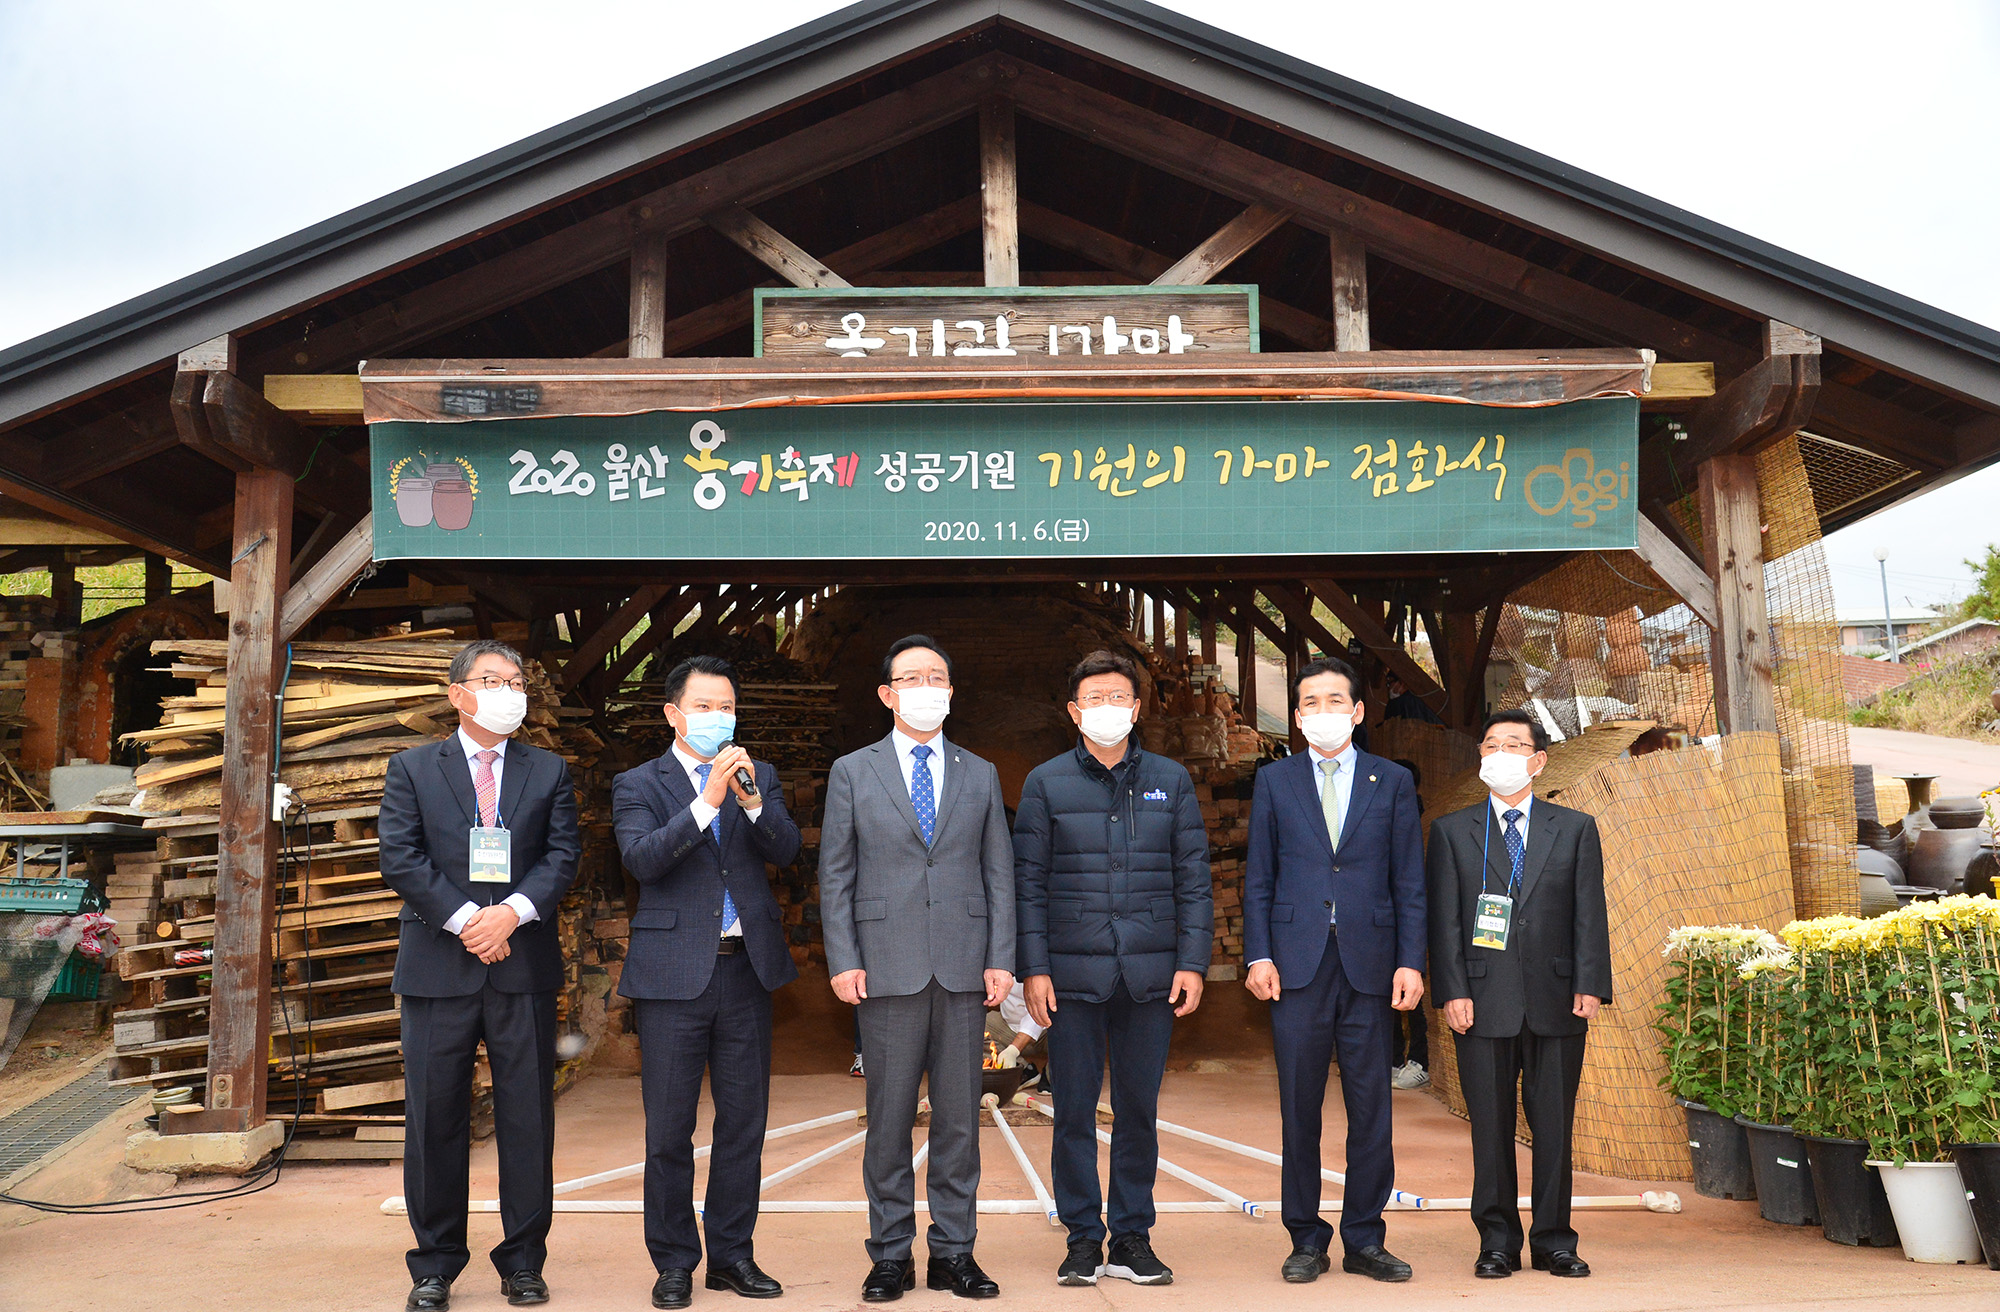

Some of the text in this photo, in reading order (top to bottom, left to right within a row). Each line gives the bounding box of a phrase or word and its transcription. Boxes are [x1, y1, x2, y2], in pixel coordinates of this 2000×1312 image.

[508, 419, 1507, 510] 2020 울산 옹기축제 성공기원 기원의 가마 점화식
[924, 520, 986, 542] 2020.
